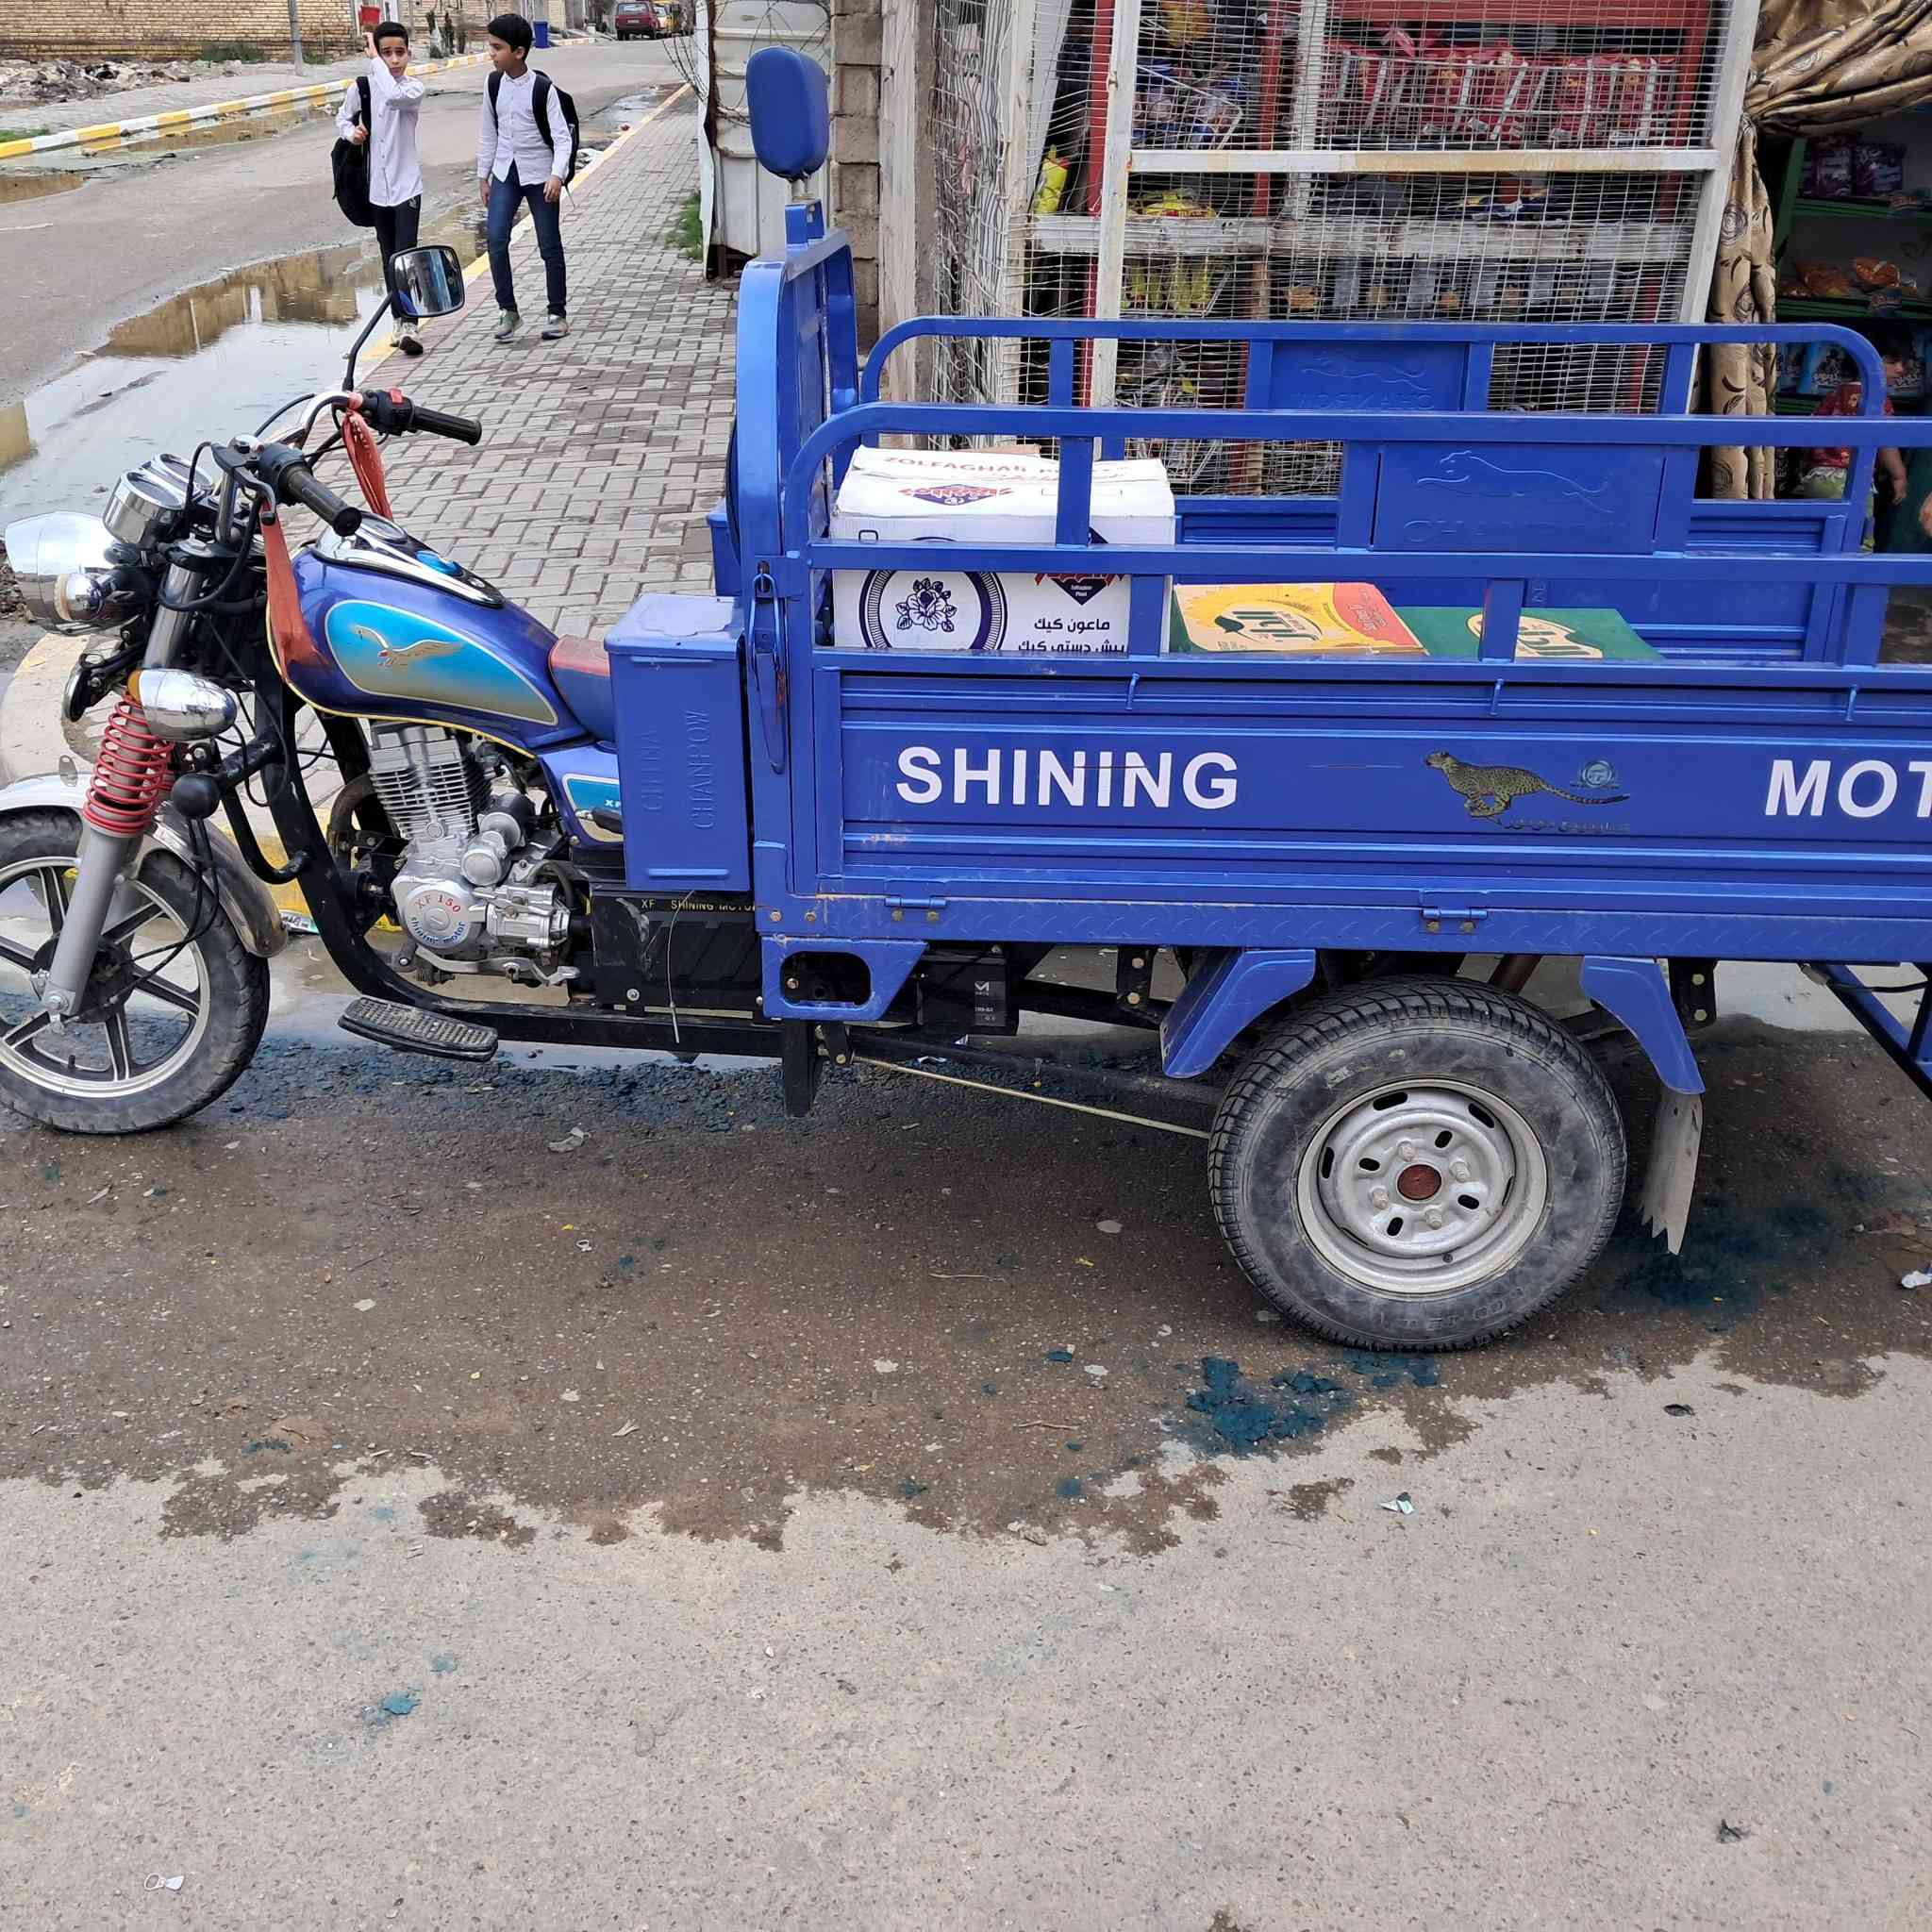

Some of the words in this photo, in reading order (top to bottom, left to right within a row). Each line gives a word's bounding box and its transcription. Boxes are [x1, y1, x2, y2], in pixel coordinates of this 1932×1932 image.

[1067, 618, 1110, 634] ماعون
[896, 746, 1239, 809] SHINING
[438, 893, 461, 912] 150
[641, 899, 656, 908] XF
[671, 899, 714, 911] SHINING
